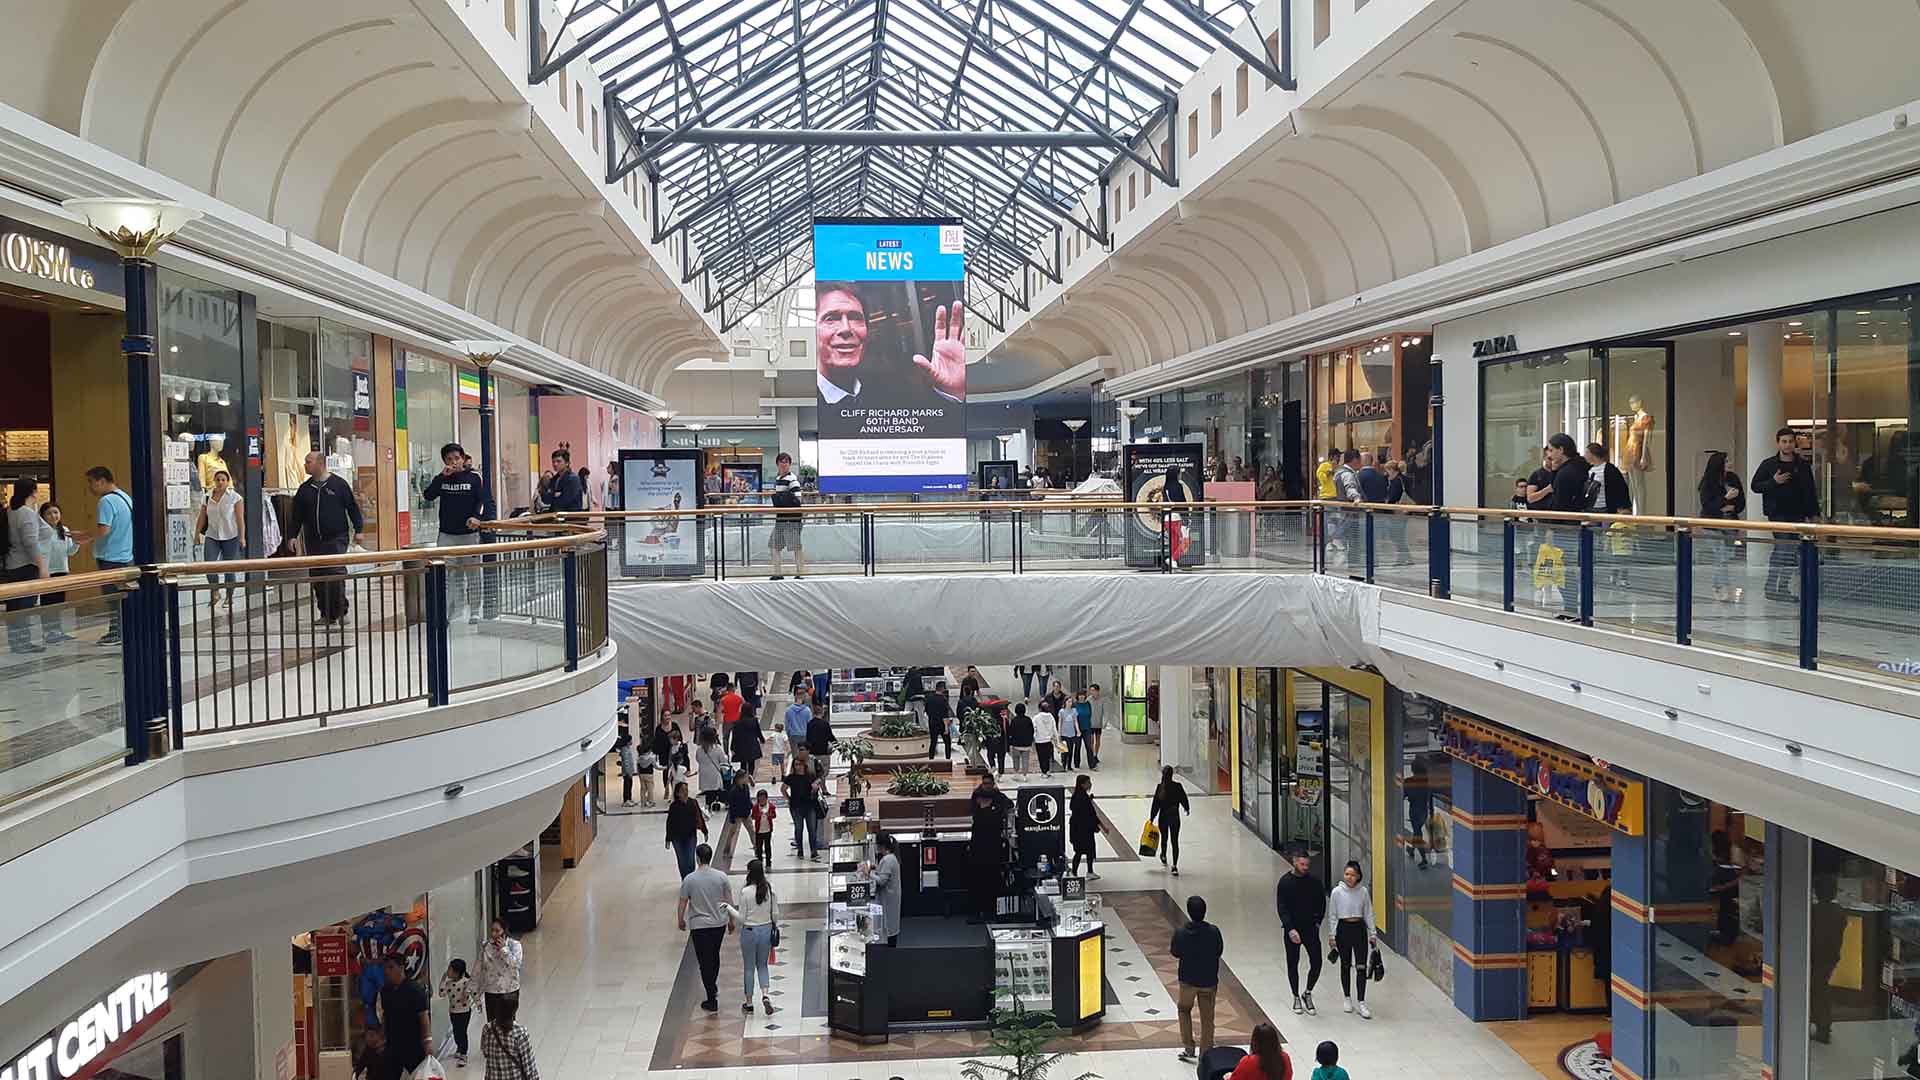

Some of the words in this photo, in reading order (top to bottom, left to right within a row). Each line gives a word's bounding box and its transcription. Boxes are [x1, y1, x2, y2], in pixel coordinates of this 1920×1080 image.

[866, 252, 913, 270] NEWS
[1472, 334, 1518, 358] ZARA
[840, 409, 866, 417] CLIFF
[868, 409, 910, 417] RICHARD
[1345, 400, 1387, 417] MOCHA
[860, 425, 925, 433] ANNIVERSARY
[866, 417, 889, 425] 60TH
[892, 417, 919, 425] BAND
[173, 537, 187, 553] OFF
[57, 971, 169, 1078] CENTRE
